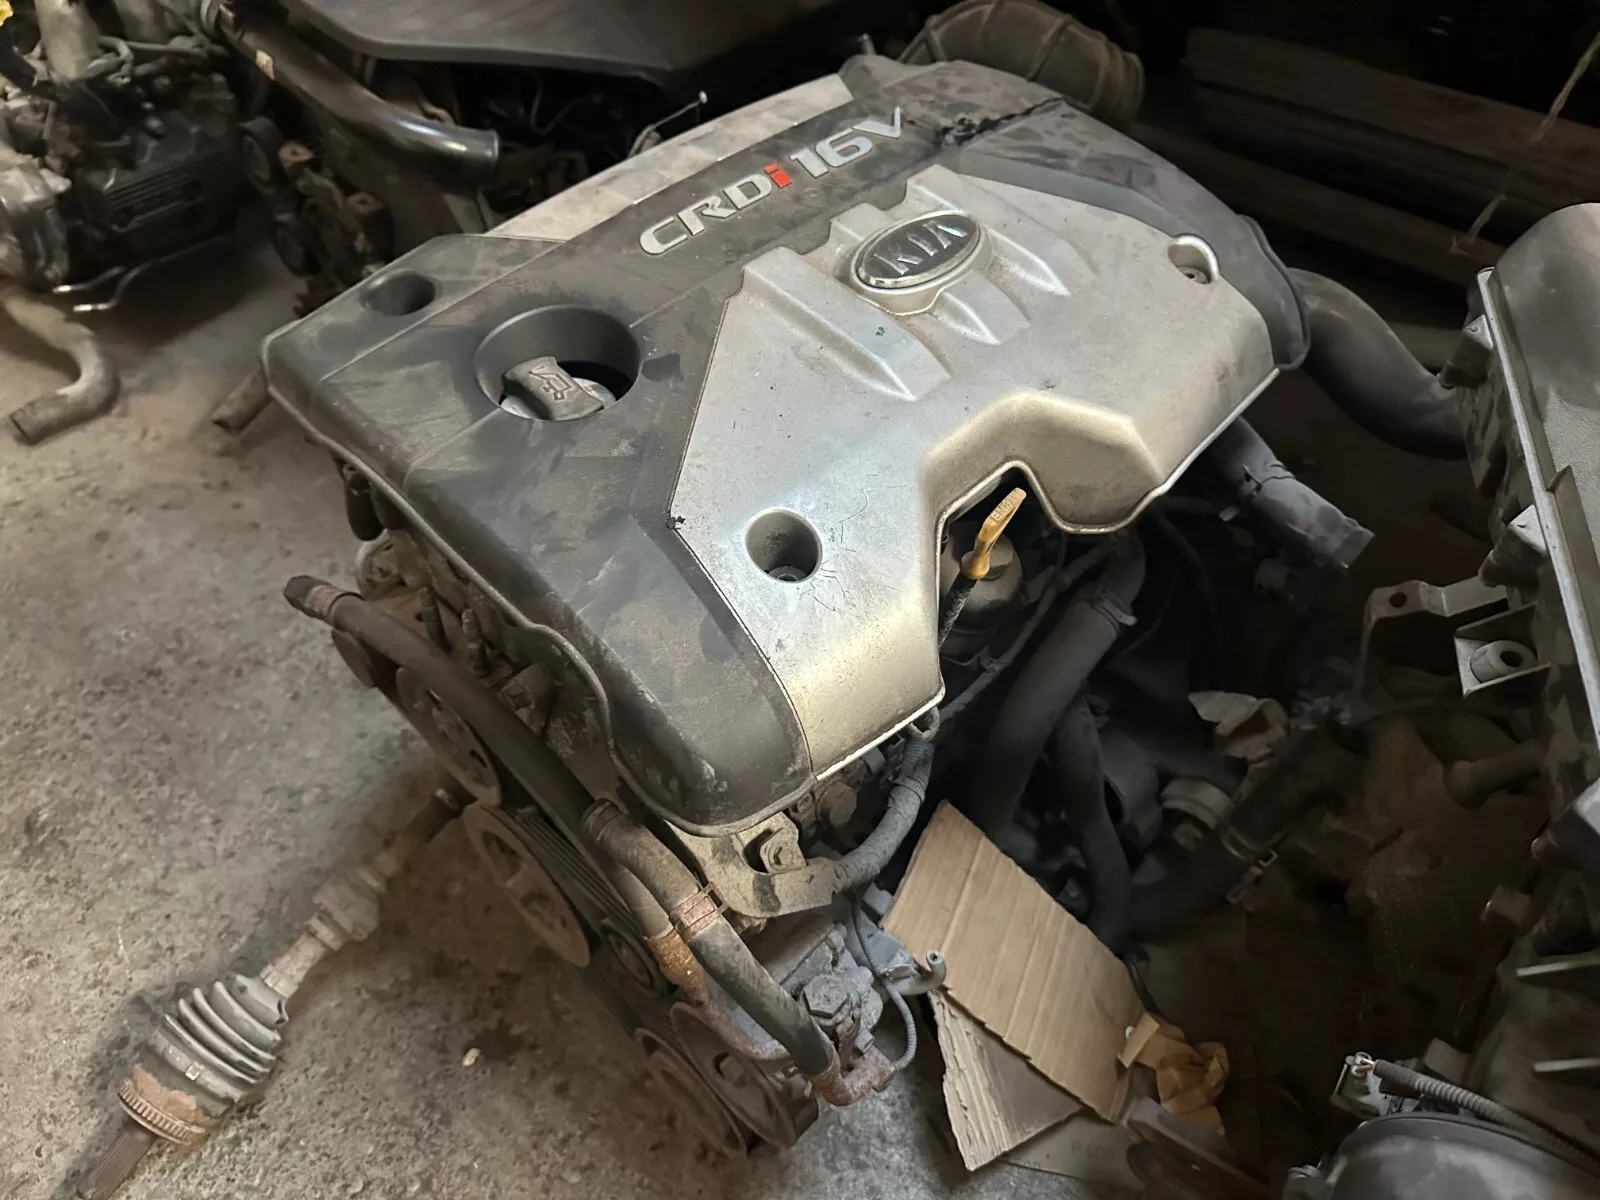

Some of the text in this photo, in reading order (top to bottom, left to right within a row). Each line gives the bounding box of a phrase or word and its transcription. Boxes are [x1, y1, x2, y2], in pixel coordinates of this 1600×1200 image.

[639, 106, 902, 256] CRDi 16V
[872, 220, 969, 276] KIA
